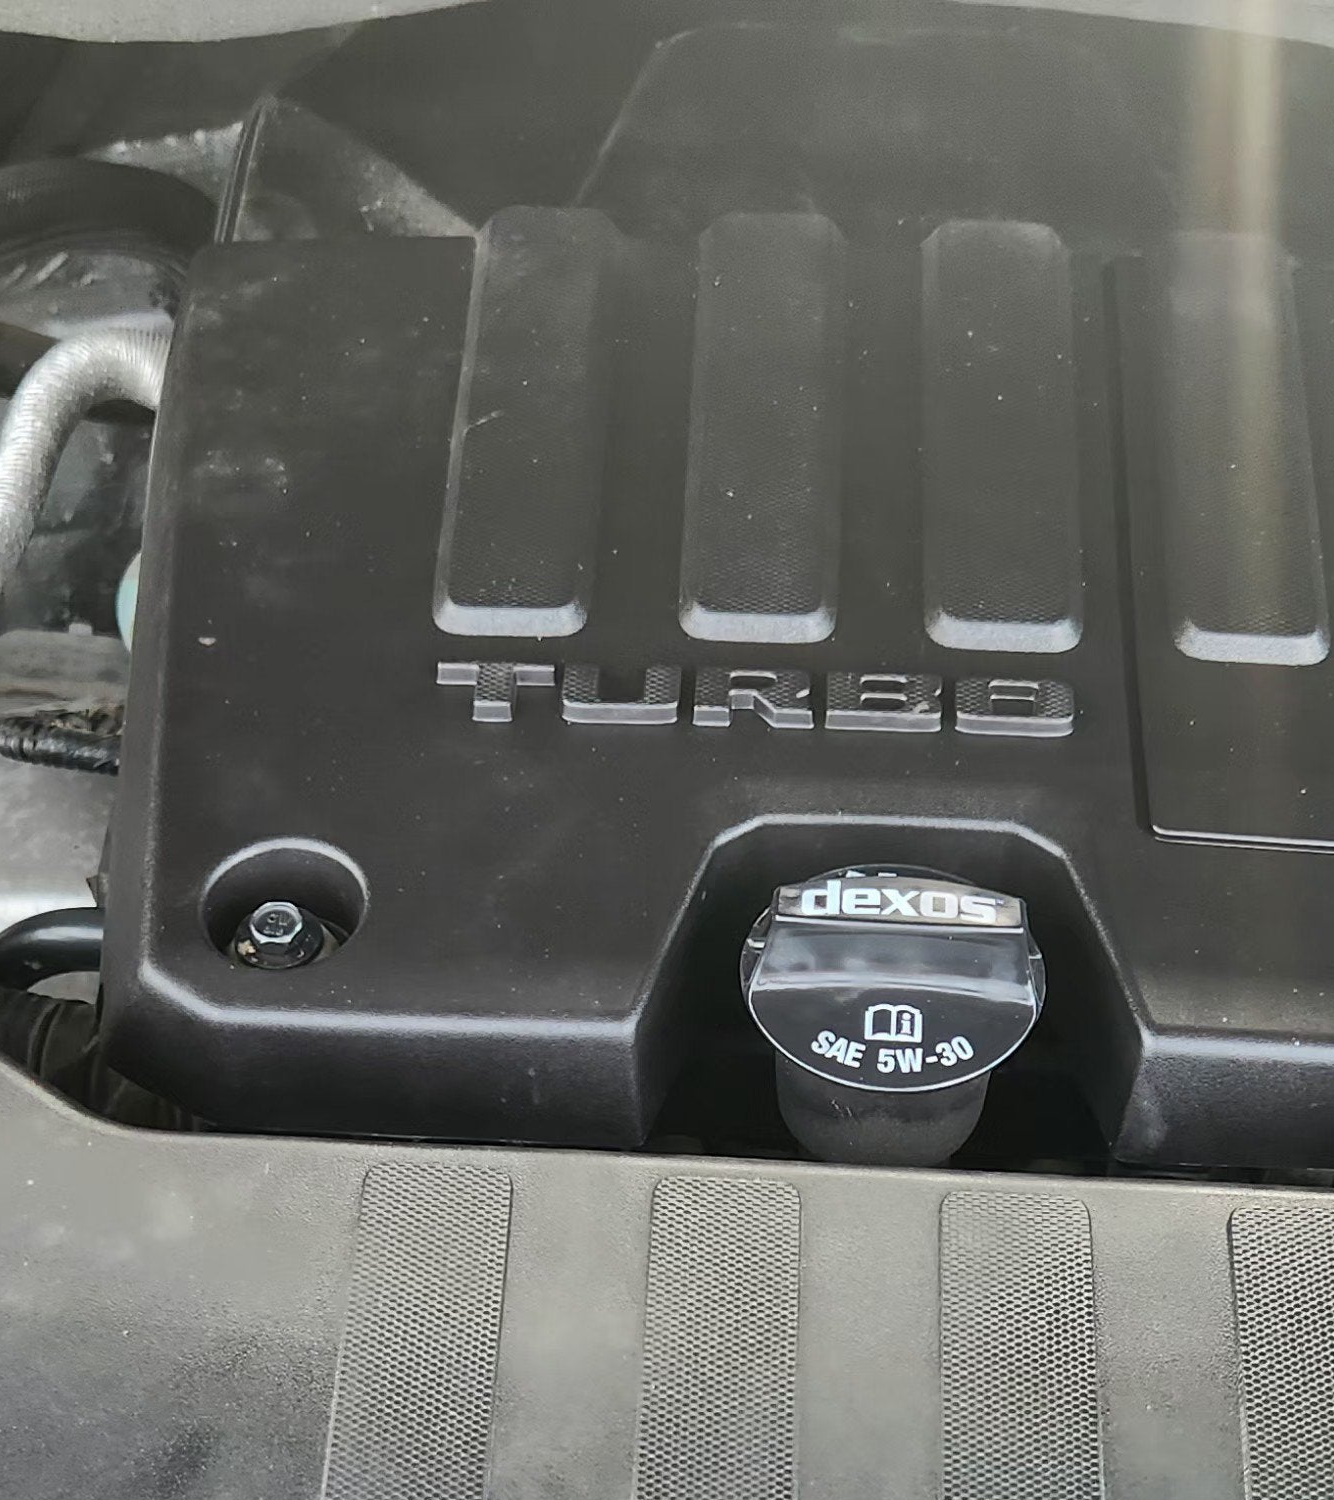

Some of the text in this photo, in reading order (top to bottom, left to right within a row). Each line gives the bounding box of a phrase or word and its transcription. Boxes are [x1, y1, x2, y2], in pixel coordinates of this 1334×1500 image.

[435, 661, 1075, 737] TURBO
[800, 879, 998, 924] dexos
[810, 1029, 975, 1074] SAE 5W-30
